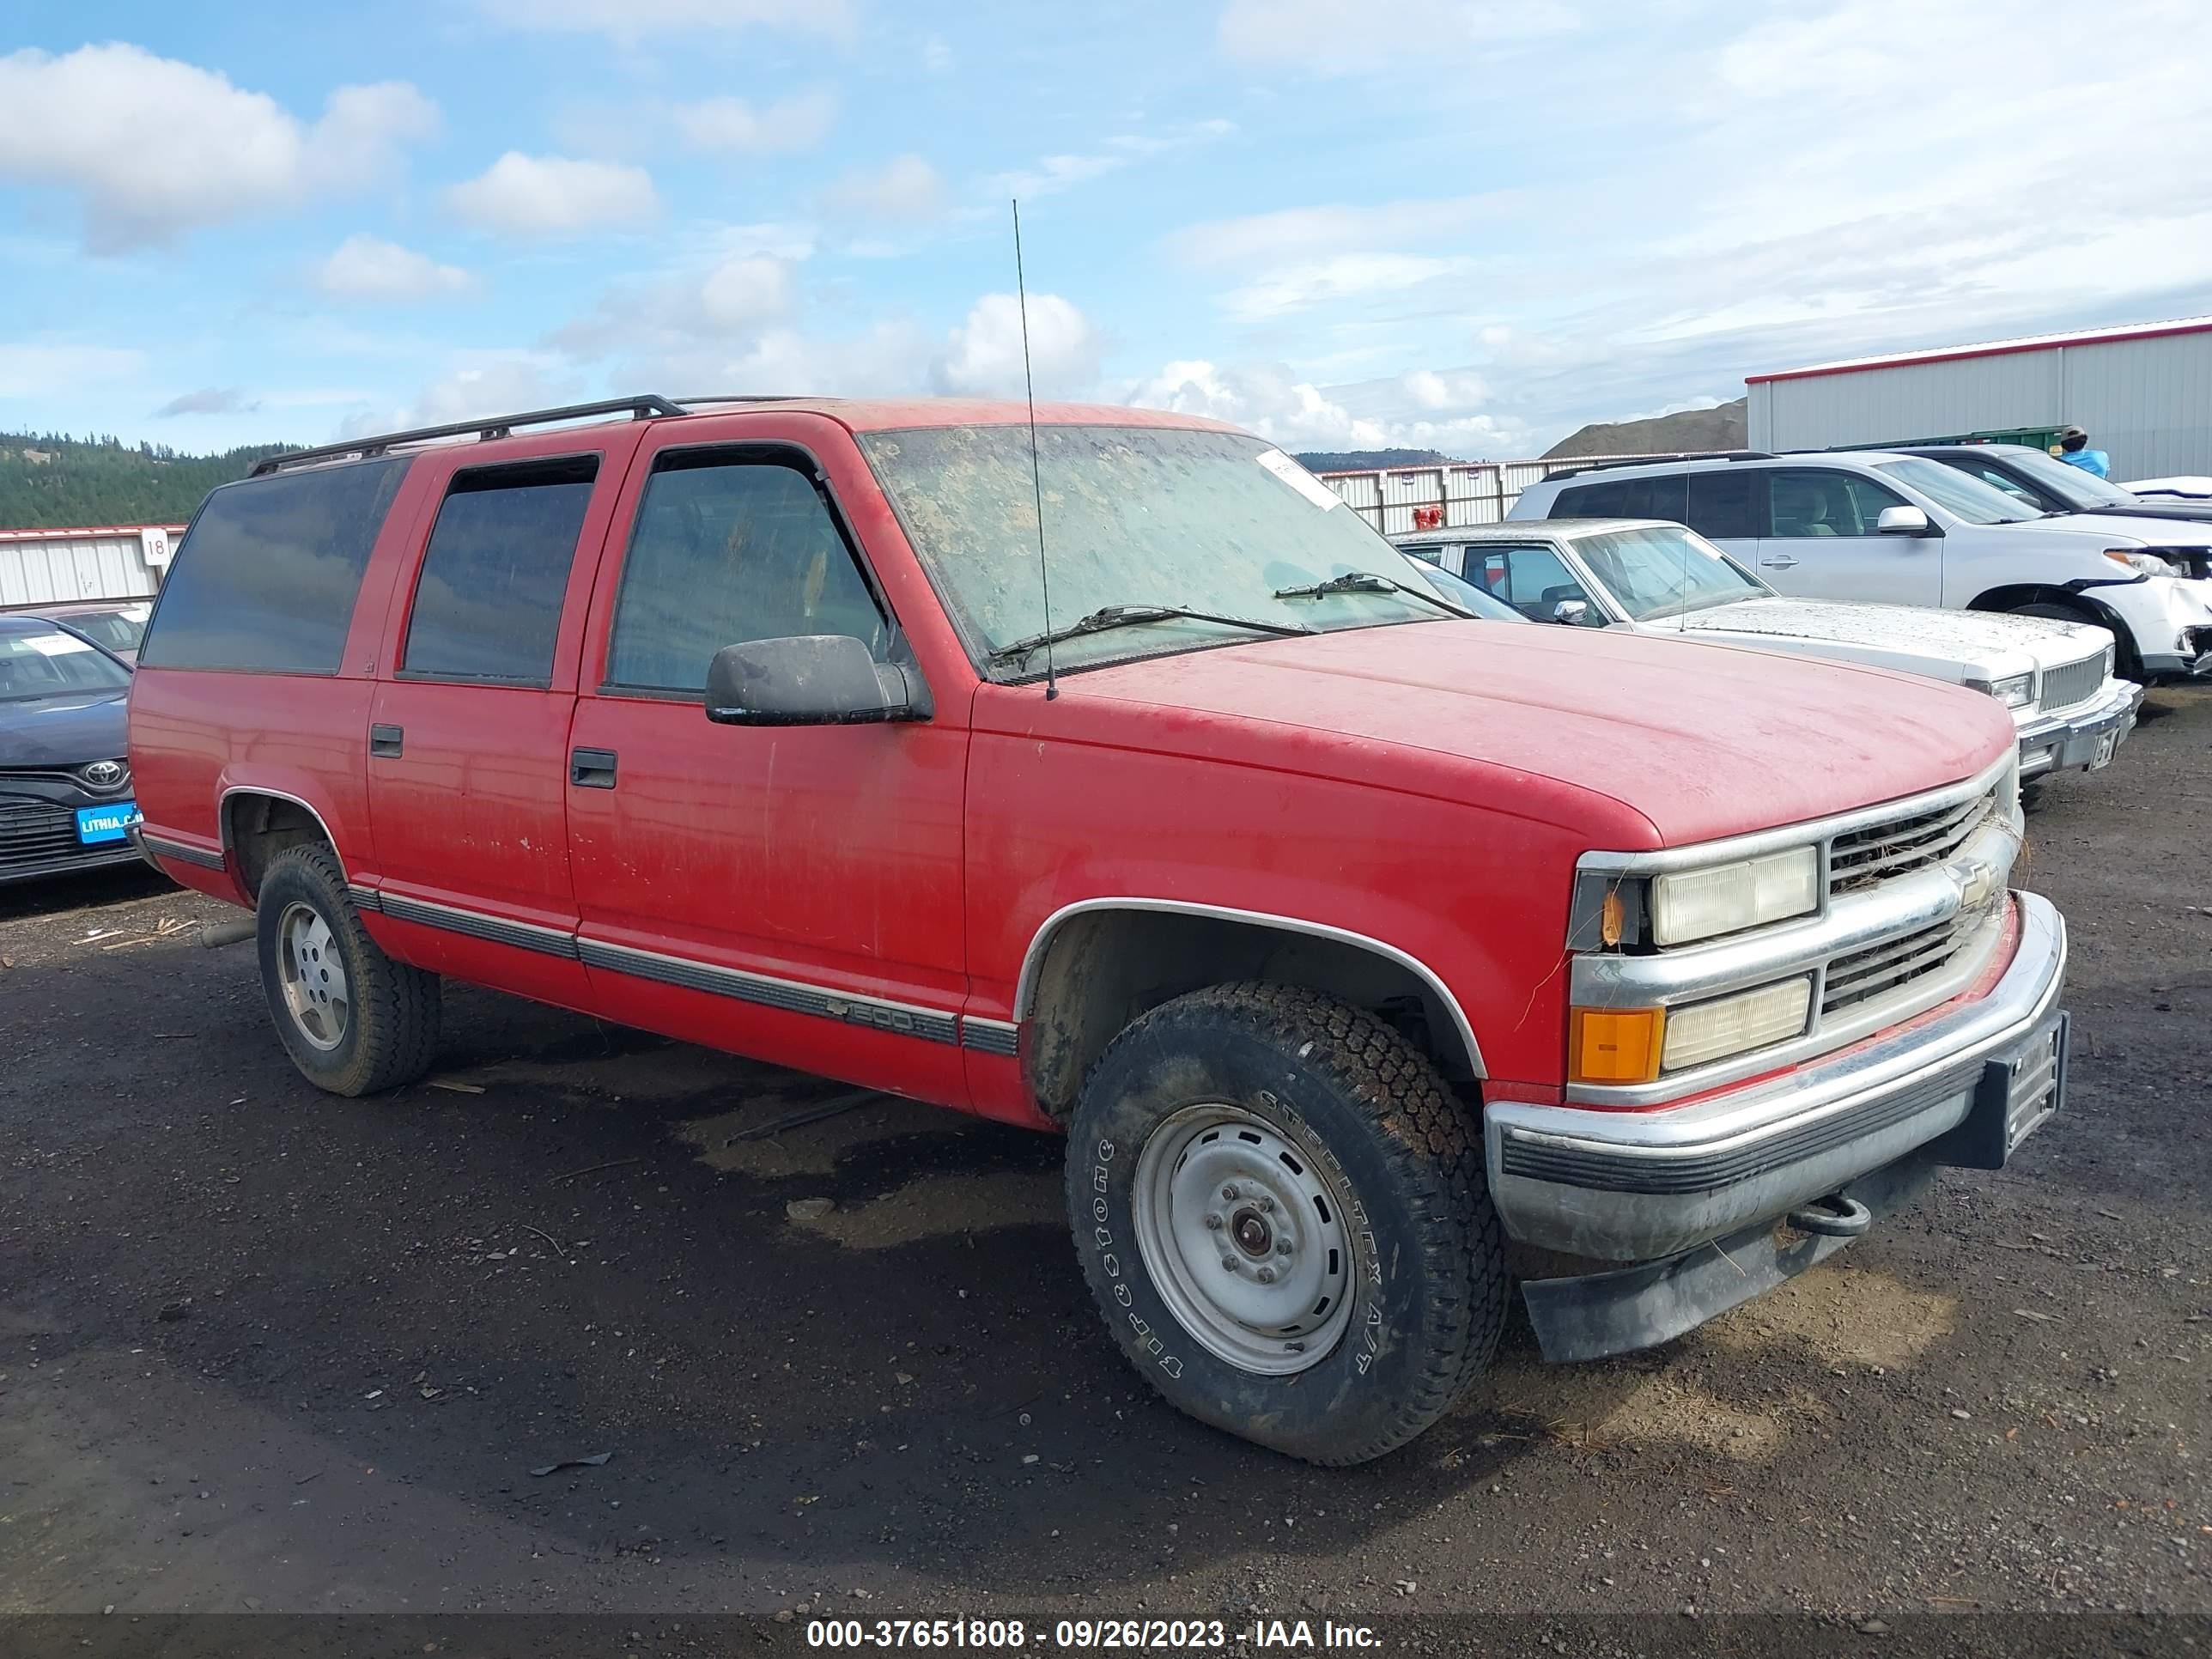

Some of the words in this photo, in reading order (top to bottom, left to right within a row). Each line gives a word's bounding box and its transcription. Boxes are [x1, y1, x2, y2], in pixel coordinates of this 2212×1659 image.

[148, 540, 165, 556] 18
[1260, 1089, 1382, 1285] STEELTEX
[1092, 1139, 1183, 1379] Firestone
[1355, 1302, 1382, 1376] A/T
